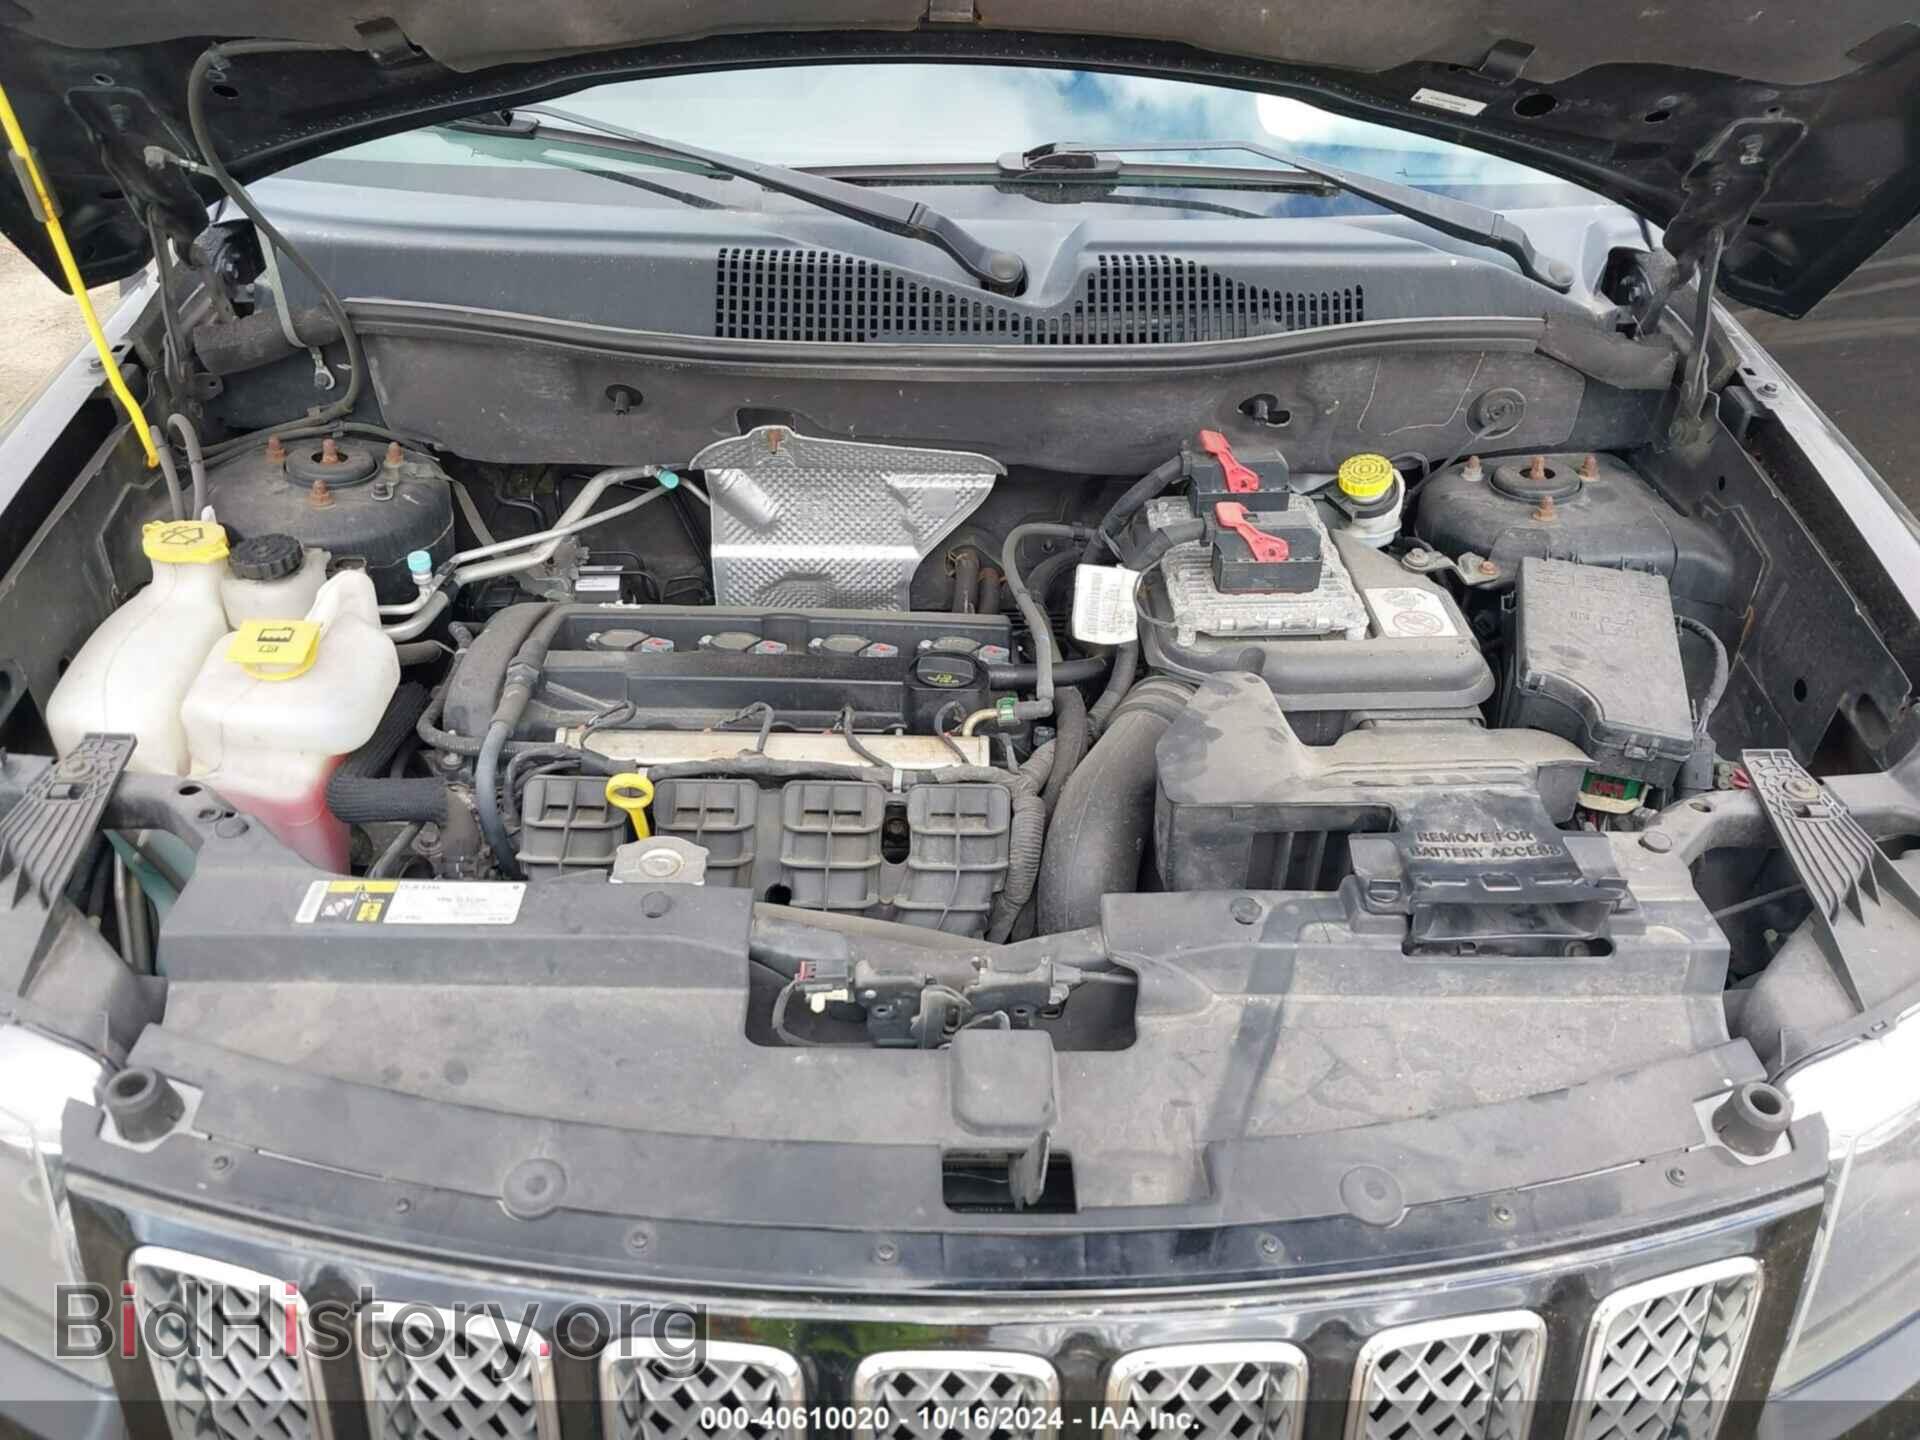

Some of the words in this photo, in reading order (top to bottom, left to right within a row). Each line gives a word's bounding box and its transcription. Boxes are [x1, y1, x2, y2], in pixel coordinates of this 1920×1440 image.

[1416, 831, 1492, 844] REMOVE
[1496, 831, 1536, 844] FOR
[1410, 846, 1484, 859] BATTERY
[1491, 845, 1562, 858] ACCESS
